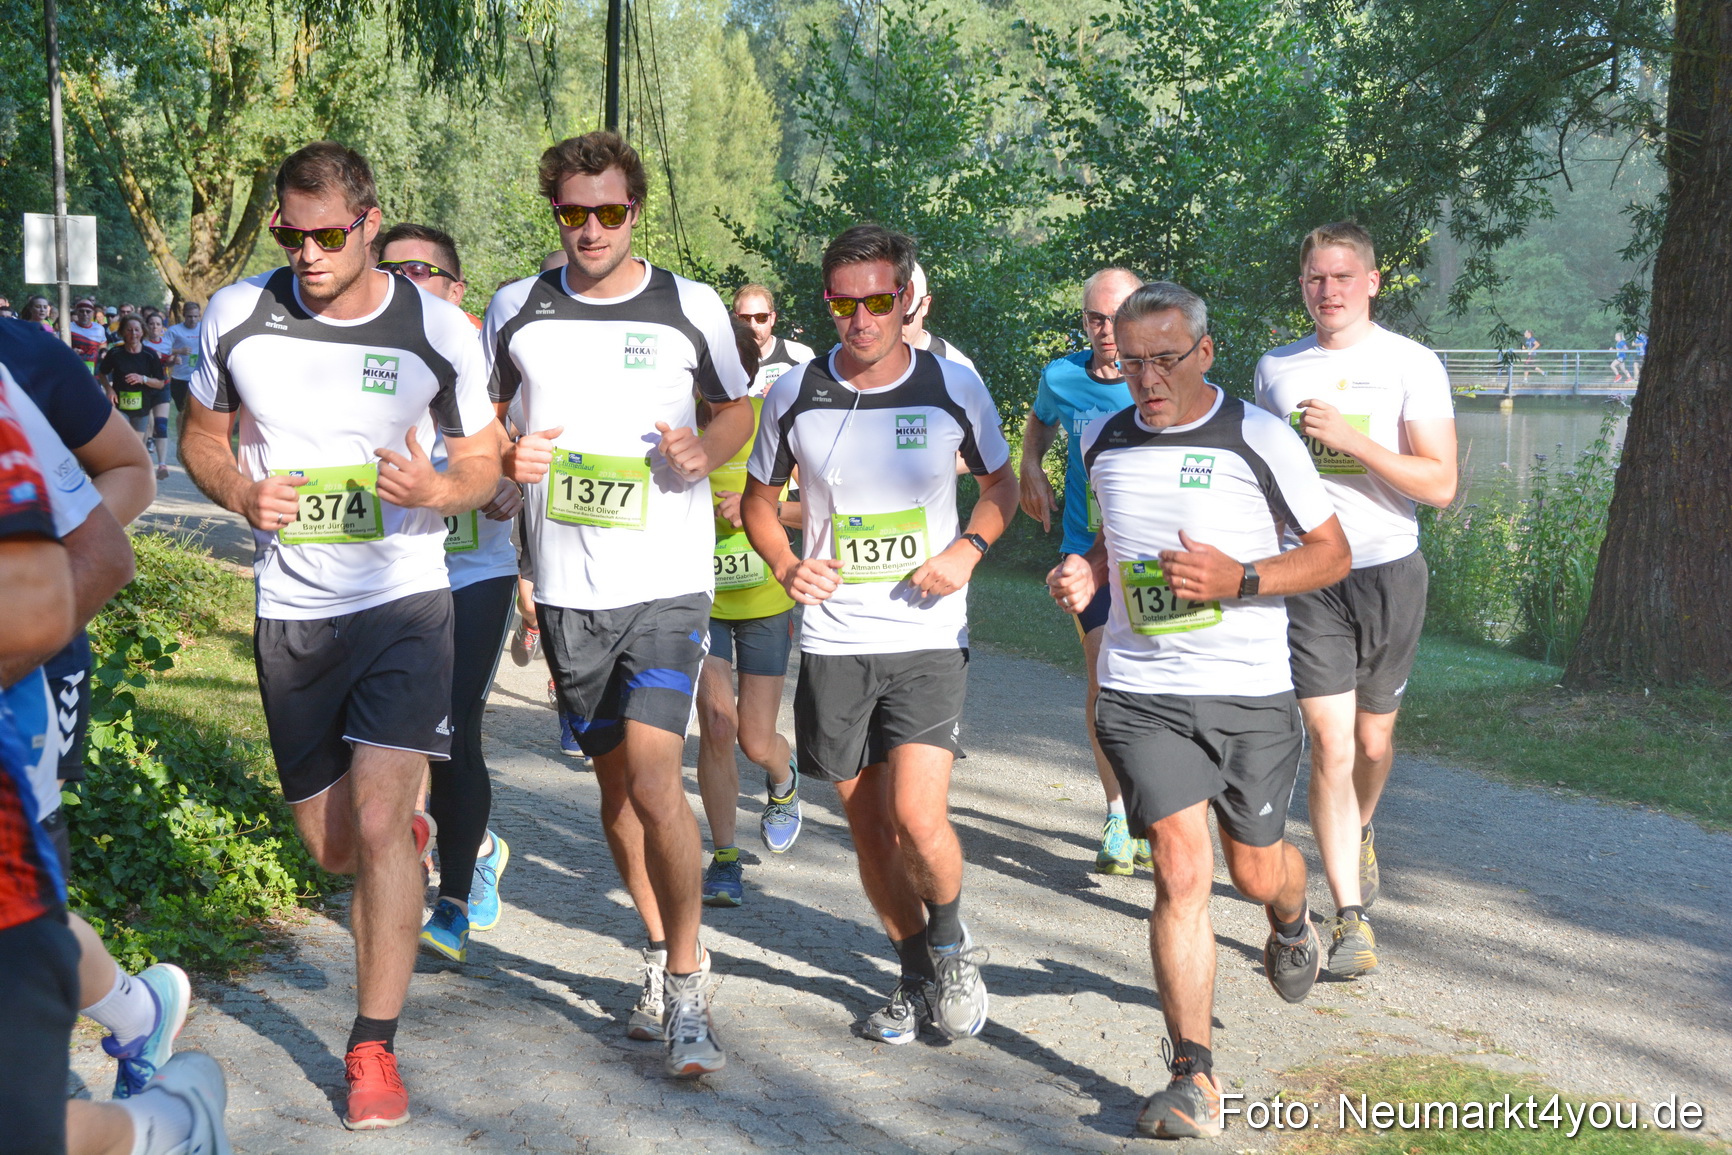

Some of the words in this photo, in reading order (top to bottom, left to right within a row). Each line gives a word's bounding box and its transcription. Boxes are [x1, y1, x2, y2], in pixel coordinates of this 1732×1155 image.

[265, 321, 288, 331] erima
[624, 346, 658, 356] MICKAN
[362, 368, 398, 380] MICKAN
[121, 397, 140, 405] 1657
[895, 427, 928, 436] MICKAN
[1323, 457, 1355, 465] Sebastian
[1180, 466, 1213, 475] MICKAN
[561, 476, 635, 507] 1377
[596, 506, 619, 515] Oliver
[303, 523, 325, 532] Bayer
[327, 521, 355, 532] Jürgen
[846, 534, 917, 563] 1370
[882, 561, 917, 570] Benjamin
[736, 572, 759, 580] Gabriele
[1142, 614, 1167, 622] Dotzler
[1169, 610, 1198, 619] Konrad
